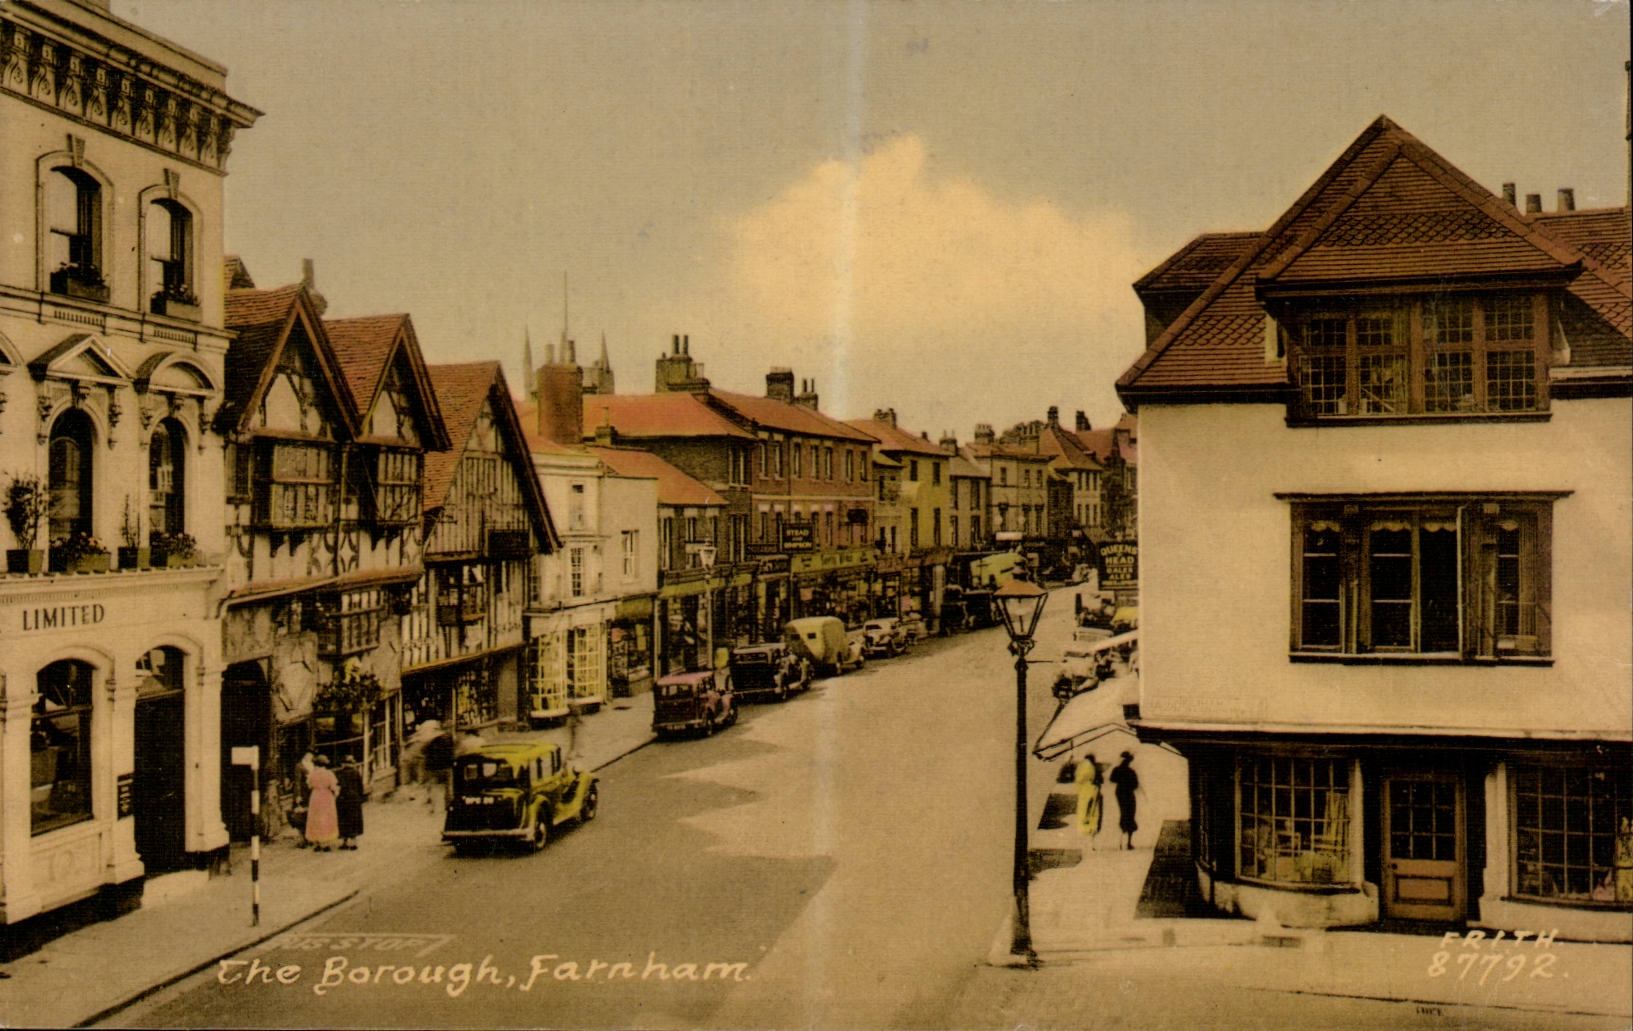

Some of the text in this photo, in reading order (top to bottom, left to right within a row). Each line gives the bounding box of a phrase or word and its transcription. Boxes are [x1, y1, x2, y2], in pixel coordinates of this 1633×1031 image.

[785, 529, 810, 537] STEAD
[1105, 556, 1135, 565] HEAD
[22, 603, 105, 631] LIMITED
[329, 937, 428, 951] STOP
